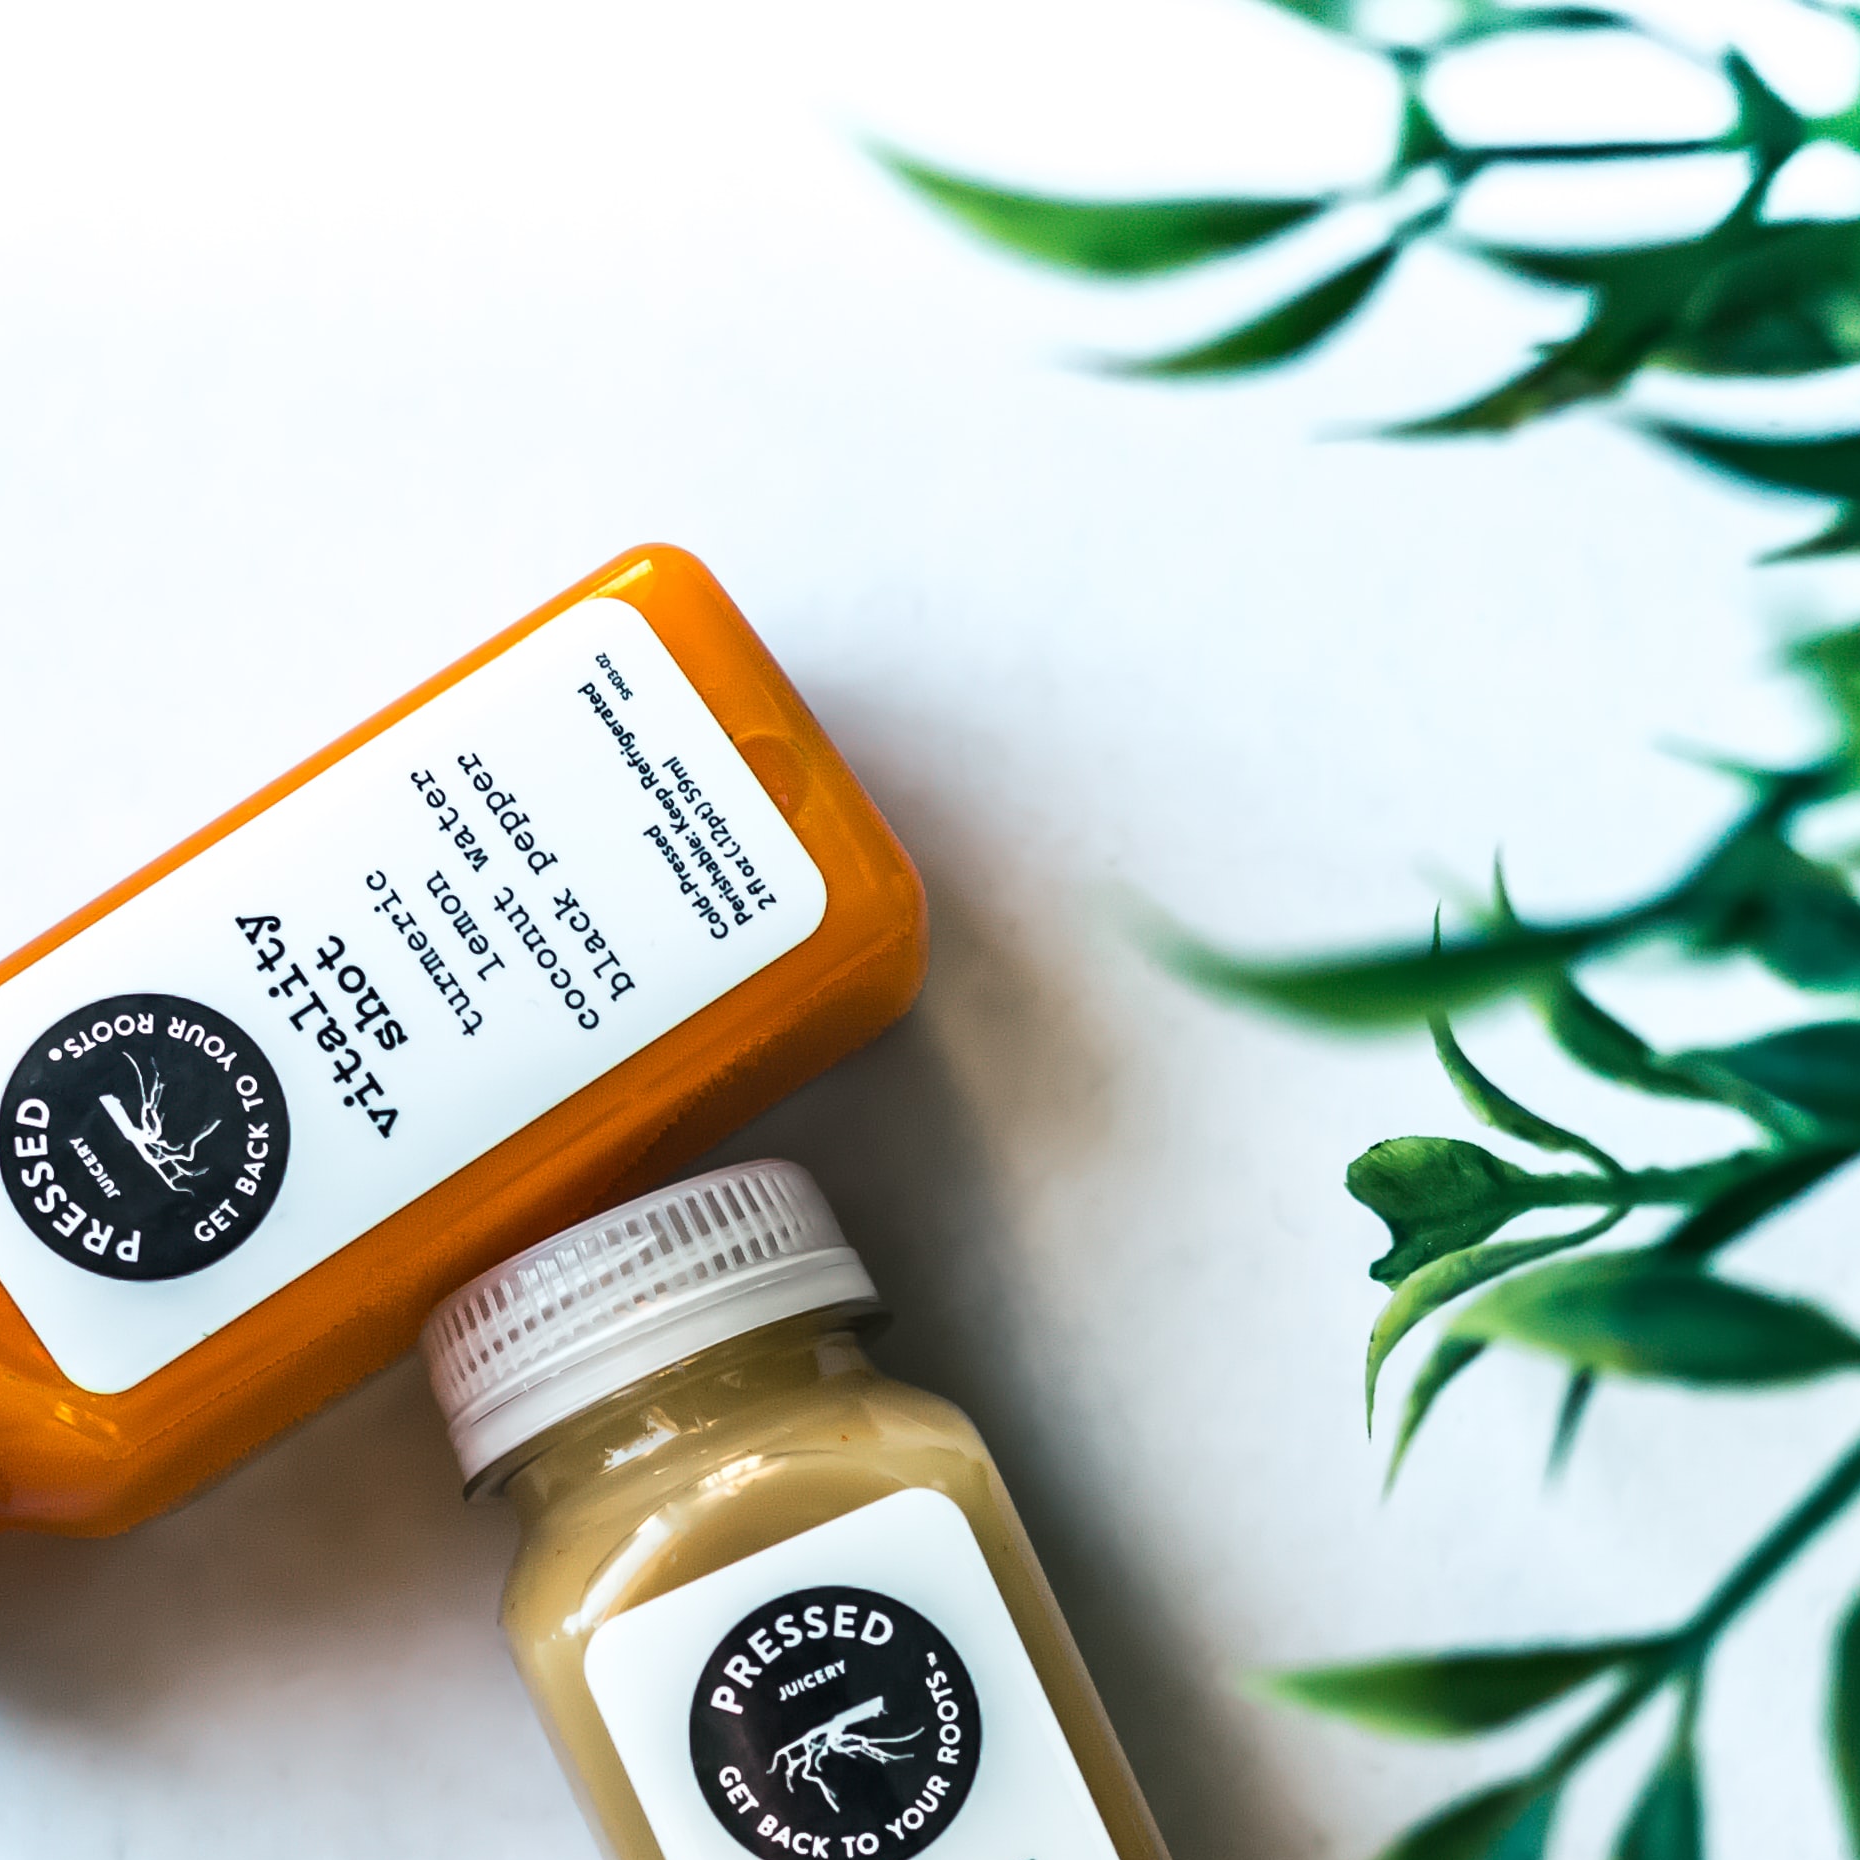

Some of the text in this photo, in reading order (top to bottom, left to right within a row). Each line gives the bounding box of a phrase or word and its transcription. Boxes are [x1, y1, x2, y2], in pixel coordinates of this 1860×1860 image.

[595, 652, 634, 701] SH03-02
[577, 682, 754, 926] Perishable: Keep Refrigerated
[661, 756, 777, 911] 2 fl oz (.12pt) 59ml
[410, 769, 600, 1030] coconut water
[426, 870, 506, 982] lemon
[457, 752, 636, 1002] black pepper
[642, 824, 729, 940] Cold-Pressed
[316, 935, 409, 1051] shot
[366, 870, 483, 1036] turmeric
[167, 1016, 238, 1072] YOUR
[234, 915, 399, 1139] vitality
[235, 1074, 264, 1113] TO
[14, 1098, 142, 1263] PRESSED
[69, 1137, 121, 1198] JUICERY
[234, 1122, 270, 1196] BACK
[194, 1198, 239, 1242] GET
[710, 1604, 894, 1715] PRESSED
[779, 1659, 846, 1702] JUICERY
[718, 1765, 760, 1814] GET
[756, 1814, 831, 1859] BACK
[840, 1832, 880, 1859] TO
[885, 1775, 951, 1841] YOUR
